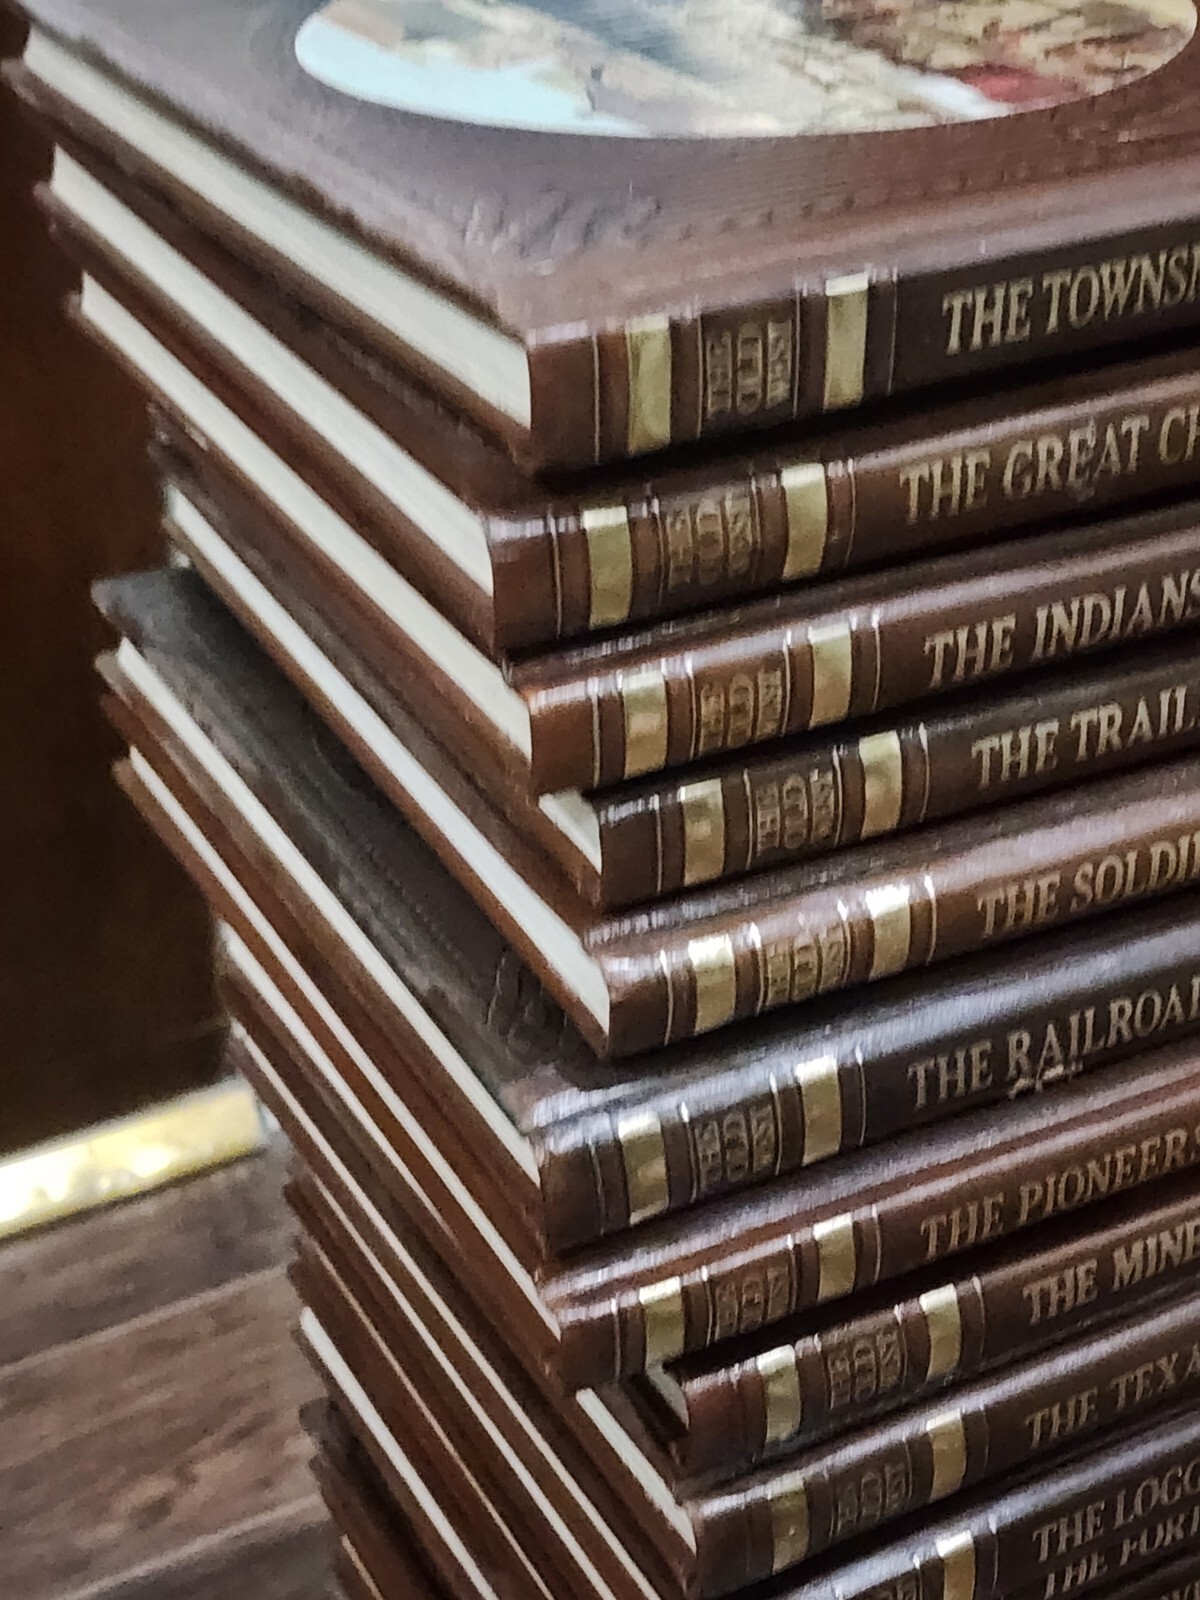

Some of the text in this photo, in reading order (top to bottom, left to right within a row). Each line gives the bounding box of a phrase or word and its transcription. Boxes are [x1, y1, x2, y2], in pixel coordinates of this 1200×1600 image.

[942, 276, 1033, 356] THE
[899, 449, 991, 525] THE
[1002, 414, 1150, 500] GREAT
[924, 612, 1016, 690] THE
[971, 718, 1059, 790] THE
[976, 869, 1061, 939] THE
[906, 1038, 994, 1113] THE
[920, 1192, 1004, 1260] THE
[1022, 1258, 1099, 1326] THE
[1025, 1388, 1099, 1449] THE
[1032, 1499, 1105, 1564] THE
